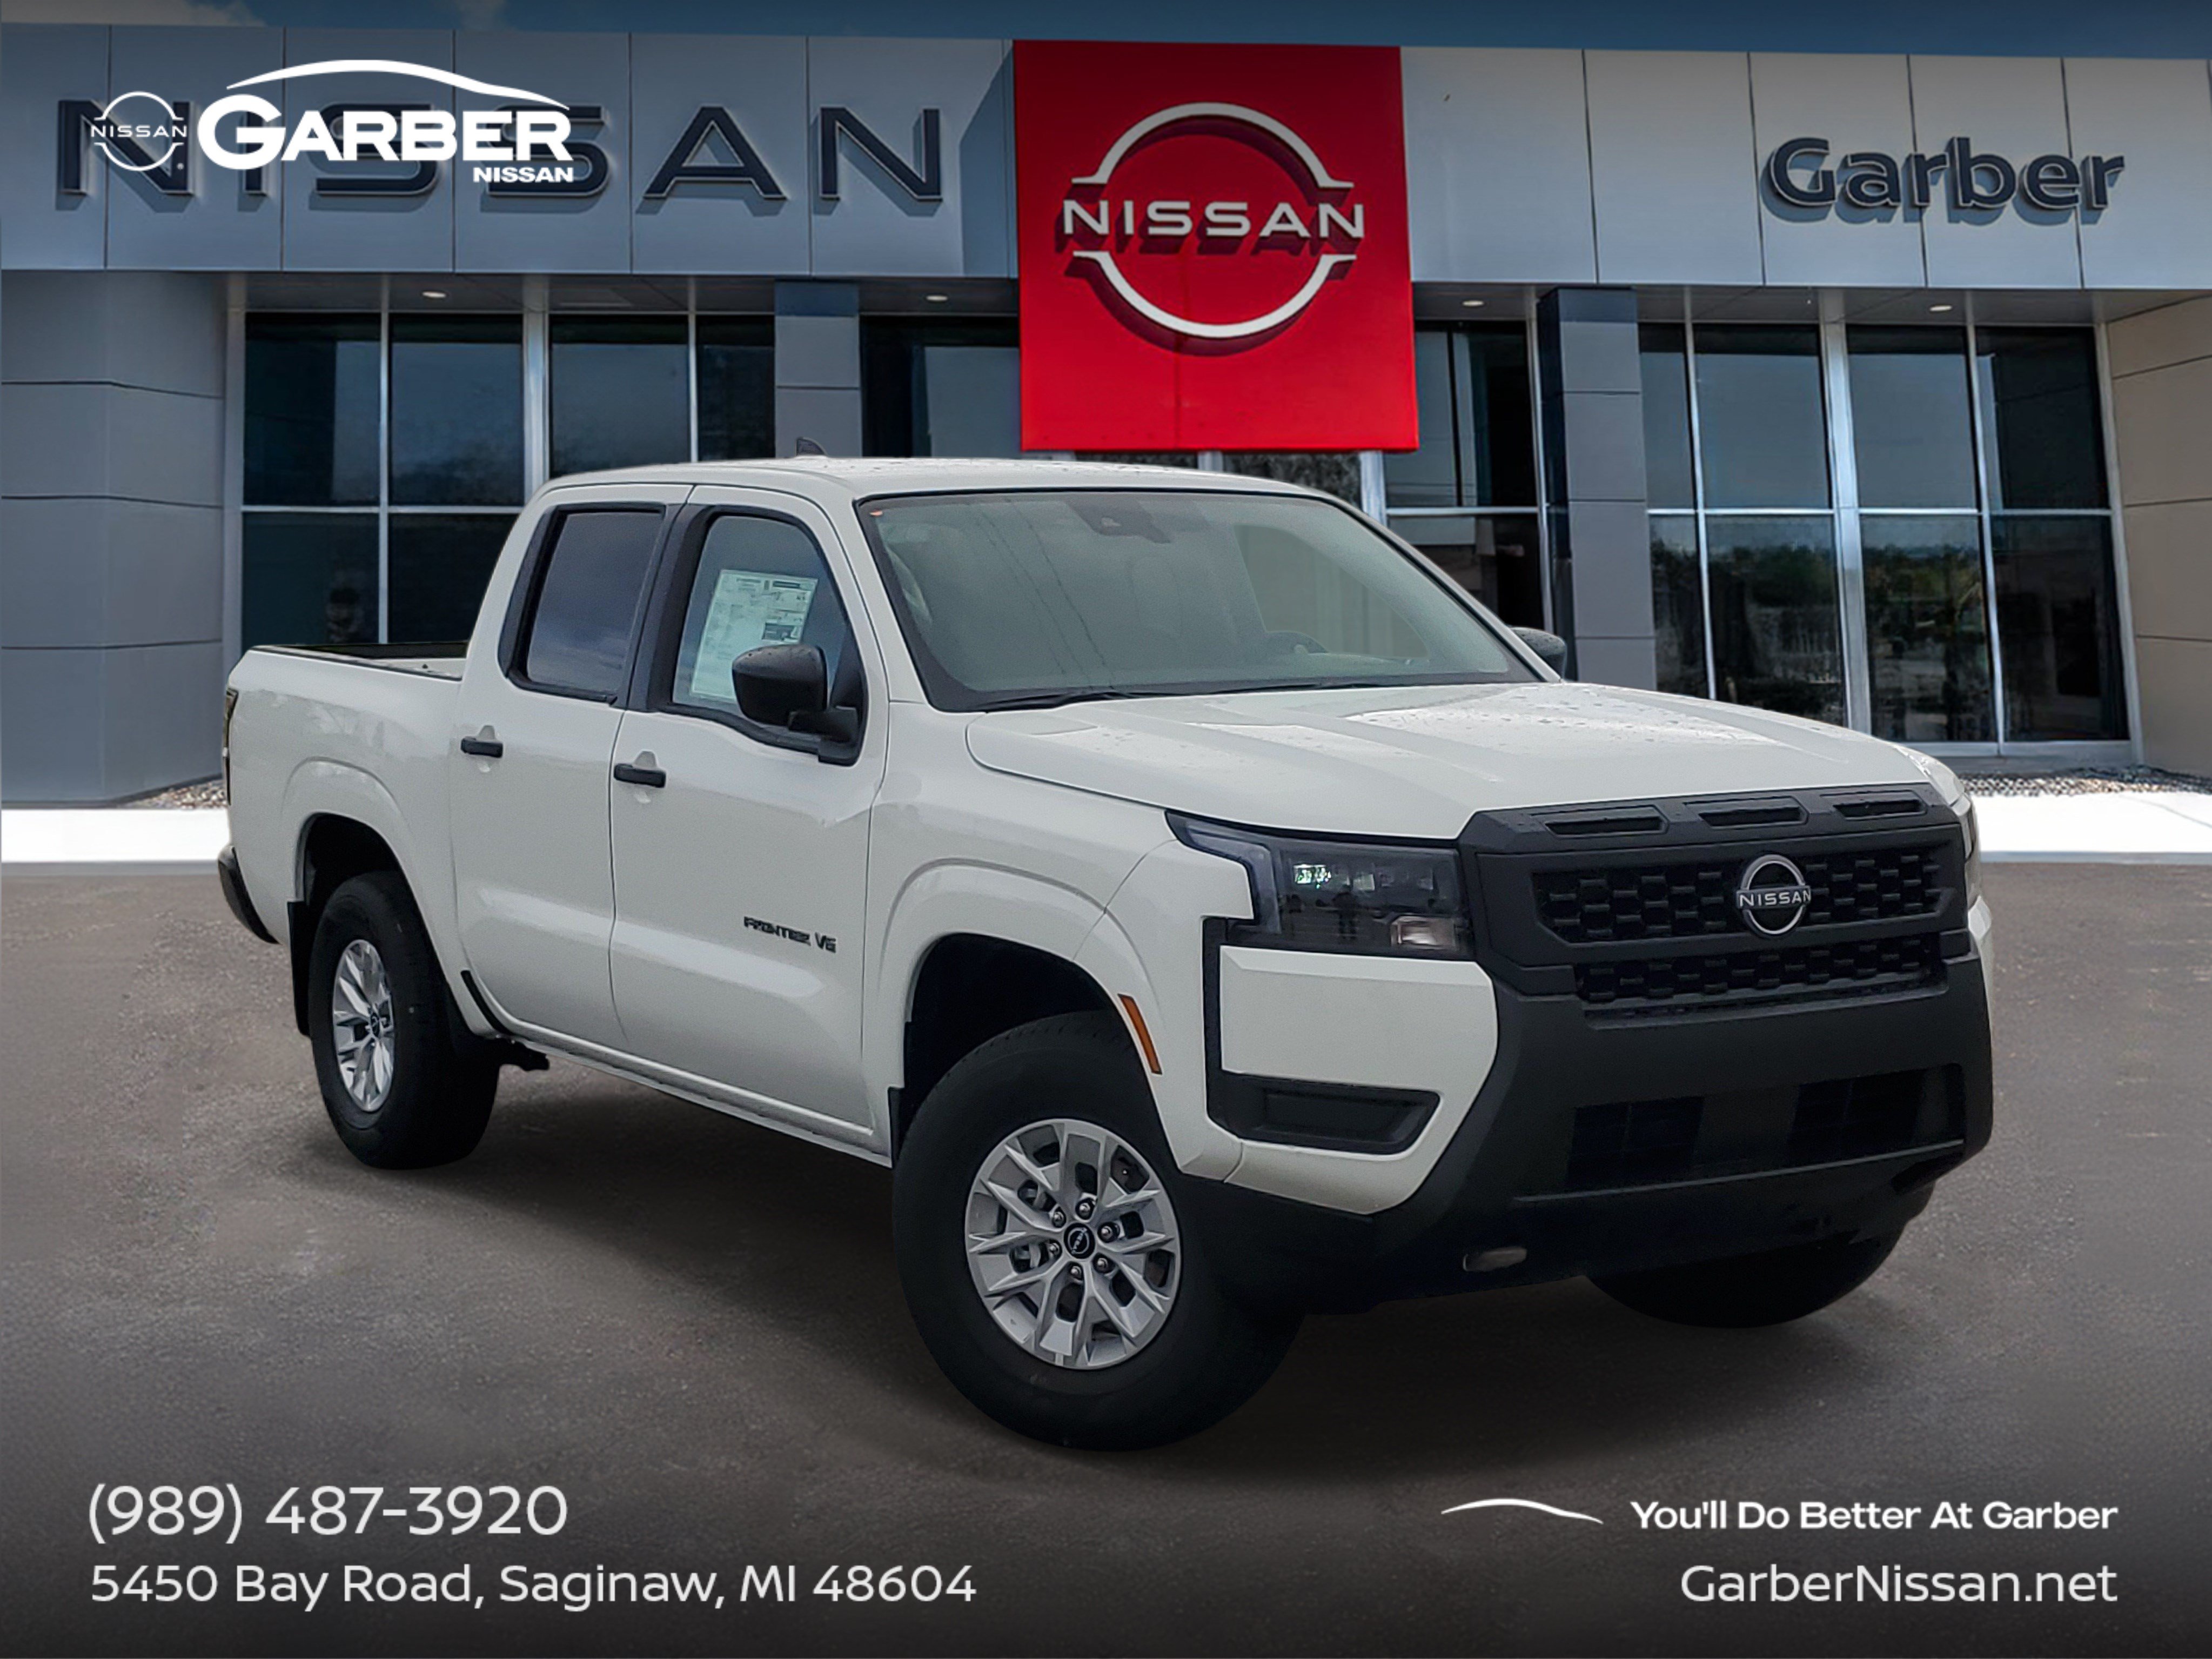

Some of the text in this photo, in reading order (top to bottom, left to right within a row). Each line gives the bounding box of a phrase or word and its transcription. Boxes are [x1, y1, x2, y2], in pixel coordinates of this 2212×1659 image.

[1770, 137, 2124, 210] Garber
[1063, 199, 1365, 238] NISSAN
[1739, 889, 1811, 907] NISSAN
[815, 932, 836, 954] V6
